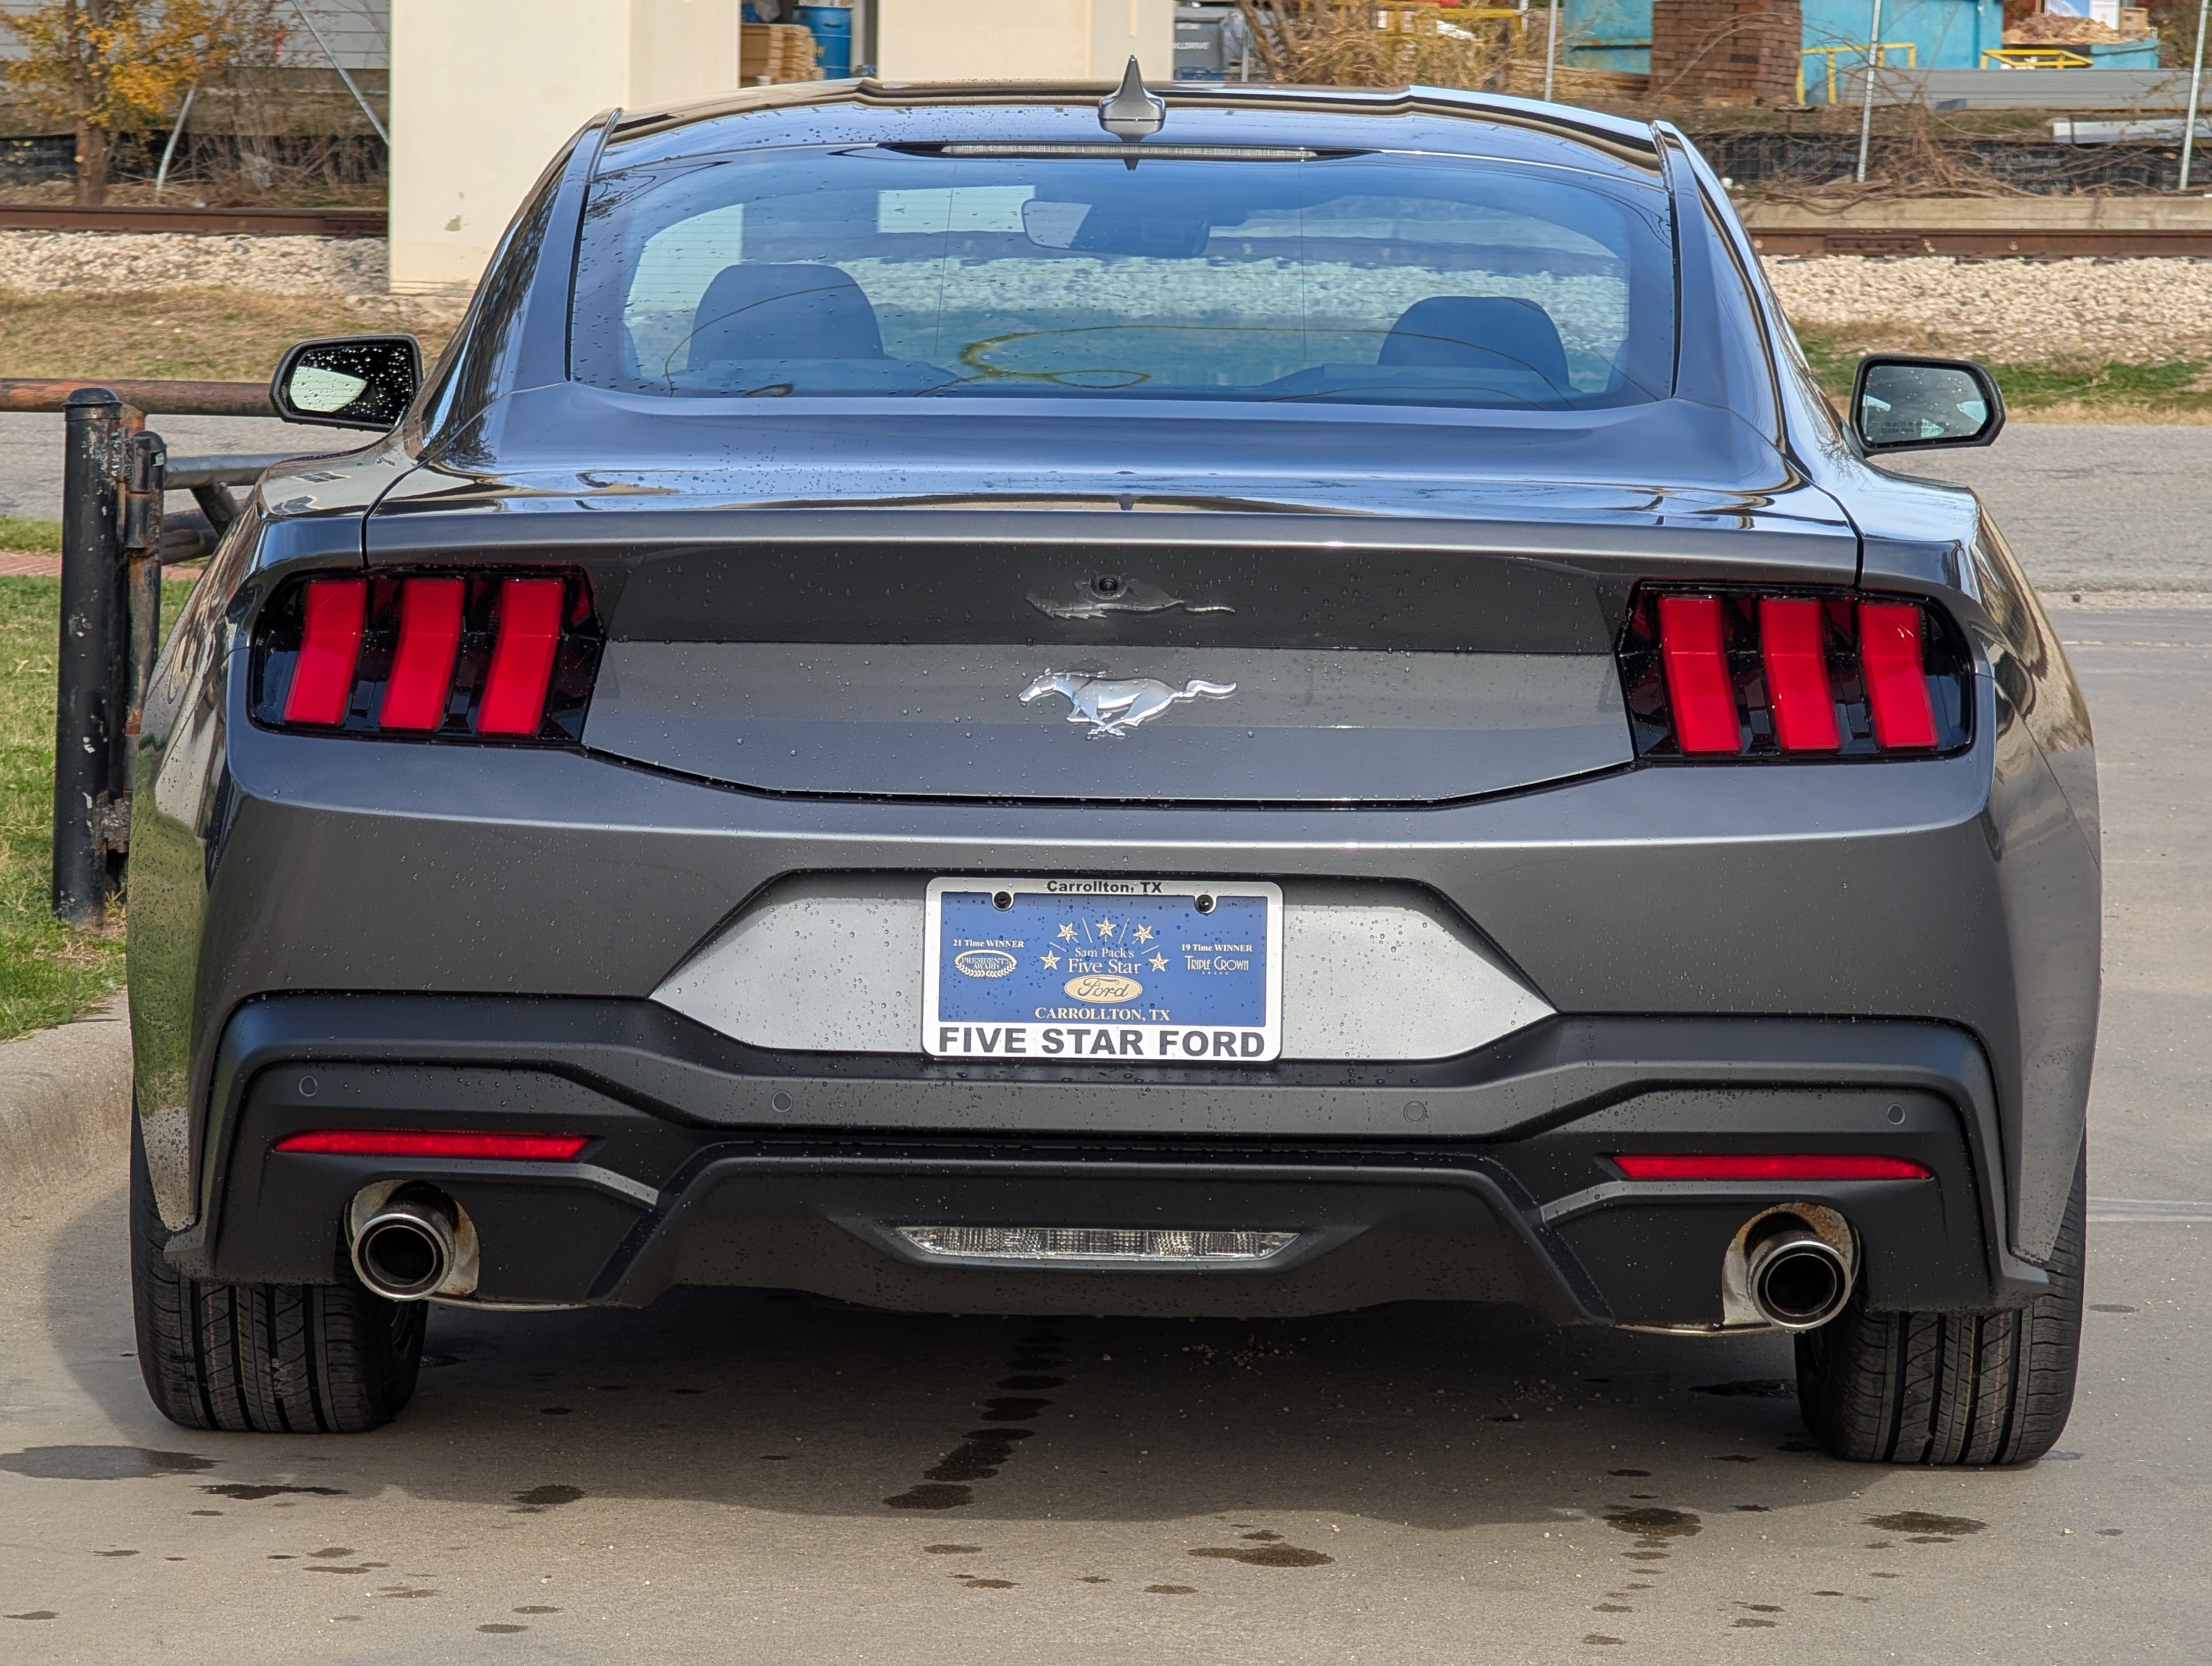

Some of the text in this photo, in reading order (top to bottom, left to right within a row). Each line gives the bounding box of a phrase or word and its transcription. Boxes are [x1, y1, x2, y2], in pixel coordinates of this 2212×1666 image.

[1046, 880, 1162, 894] Carrollton, TX
[986, 940, 1025, 948] WINNER
[1214, 944, 1253, 952] WINNER
[1075, 947, 1135, 958] Sam Pack's
[1068, 958, 1141, 974] Five Star
[1077, 978, 1130, 997] Ford
[1034, 1007, 1171, 1022] CARROLLTON, TX
[938, 1027, 1265, 1058] FIVE STAR FORD
